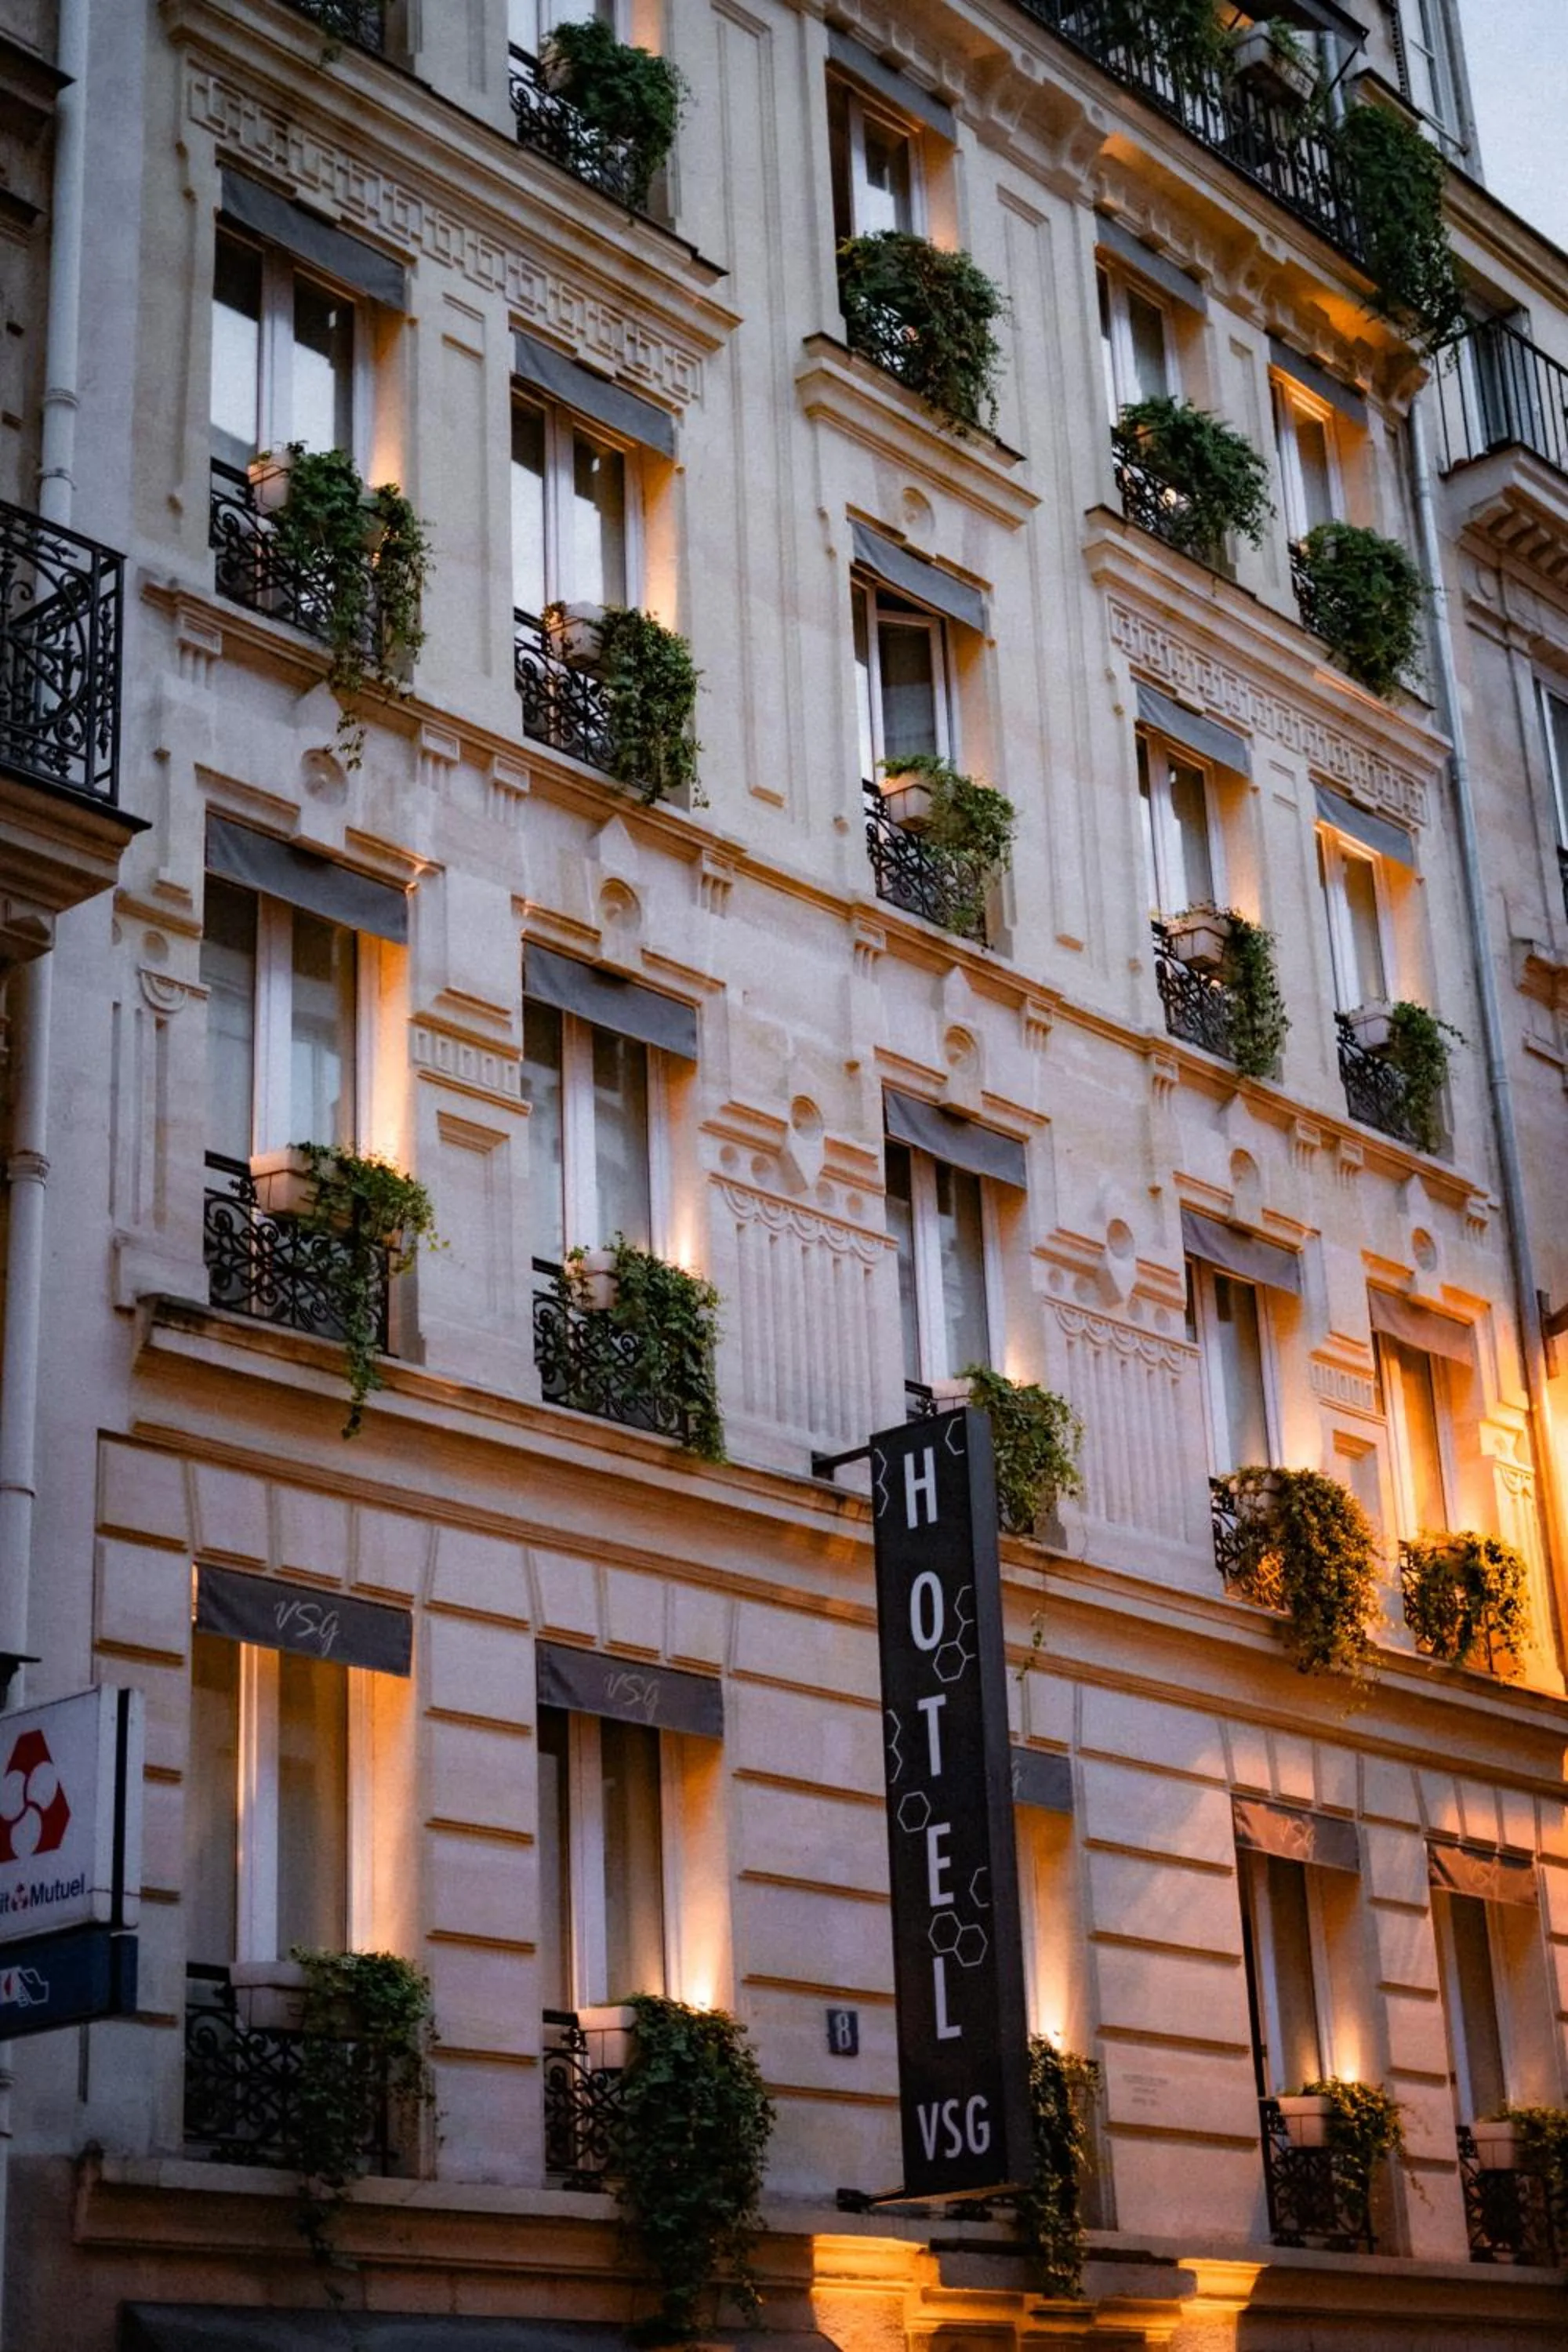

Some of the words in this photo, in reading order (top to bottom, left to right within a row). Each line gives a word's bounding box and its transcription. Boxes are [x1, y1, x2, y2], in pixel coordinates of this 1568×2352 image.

[273, 1600, 339, 1658] VSG
[903, 1446, 963, 2040] HOTEL
[30, 1873, 85, 1907] Mutuel
[836, 2013, 851, 2048] 8
[917, 2094, 991, 2162] VSG
